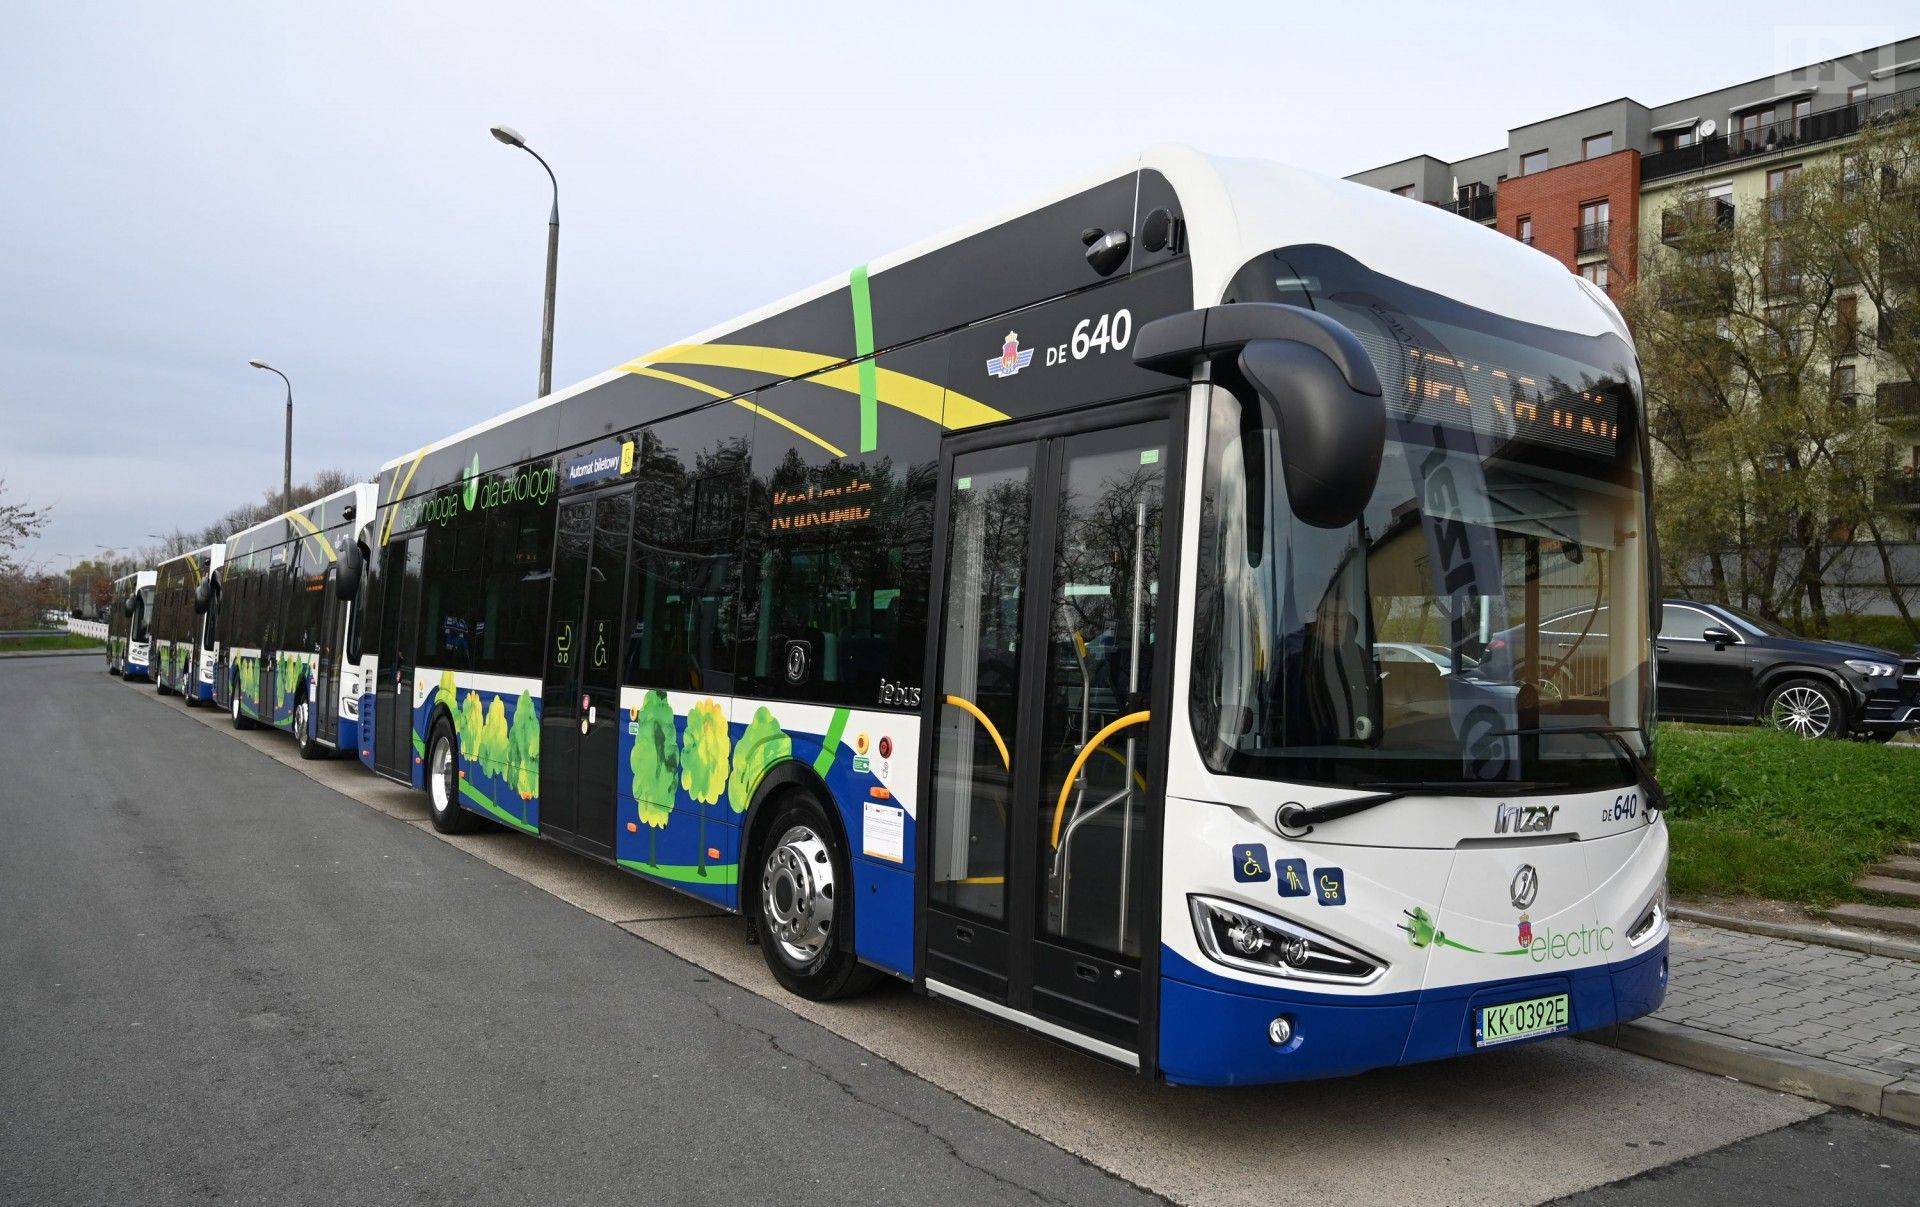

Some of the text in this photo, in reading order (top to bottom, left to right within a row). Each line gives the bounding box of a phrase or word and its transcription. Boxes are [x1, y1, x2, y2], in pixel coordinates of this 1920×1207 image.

[1046, 308, 1132, 367] DE 640
[480, 480, 499, 509] dla
[501, 462, 556, 507] ekologii
[569, 462, 593, 480] Automat
[594, 456, 619, 474] biletowy
[1602, 793, 1638, 823] DE 640
[1531, 920, 1615, 963] electric
